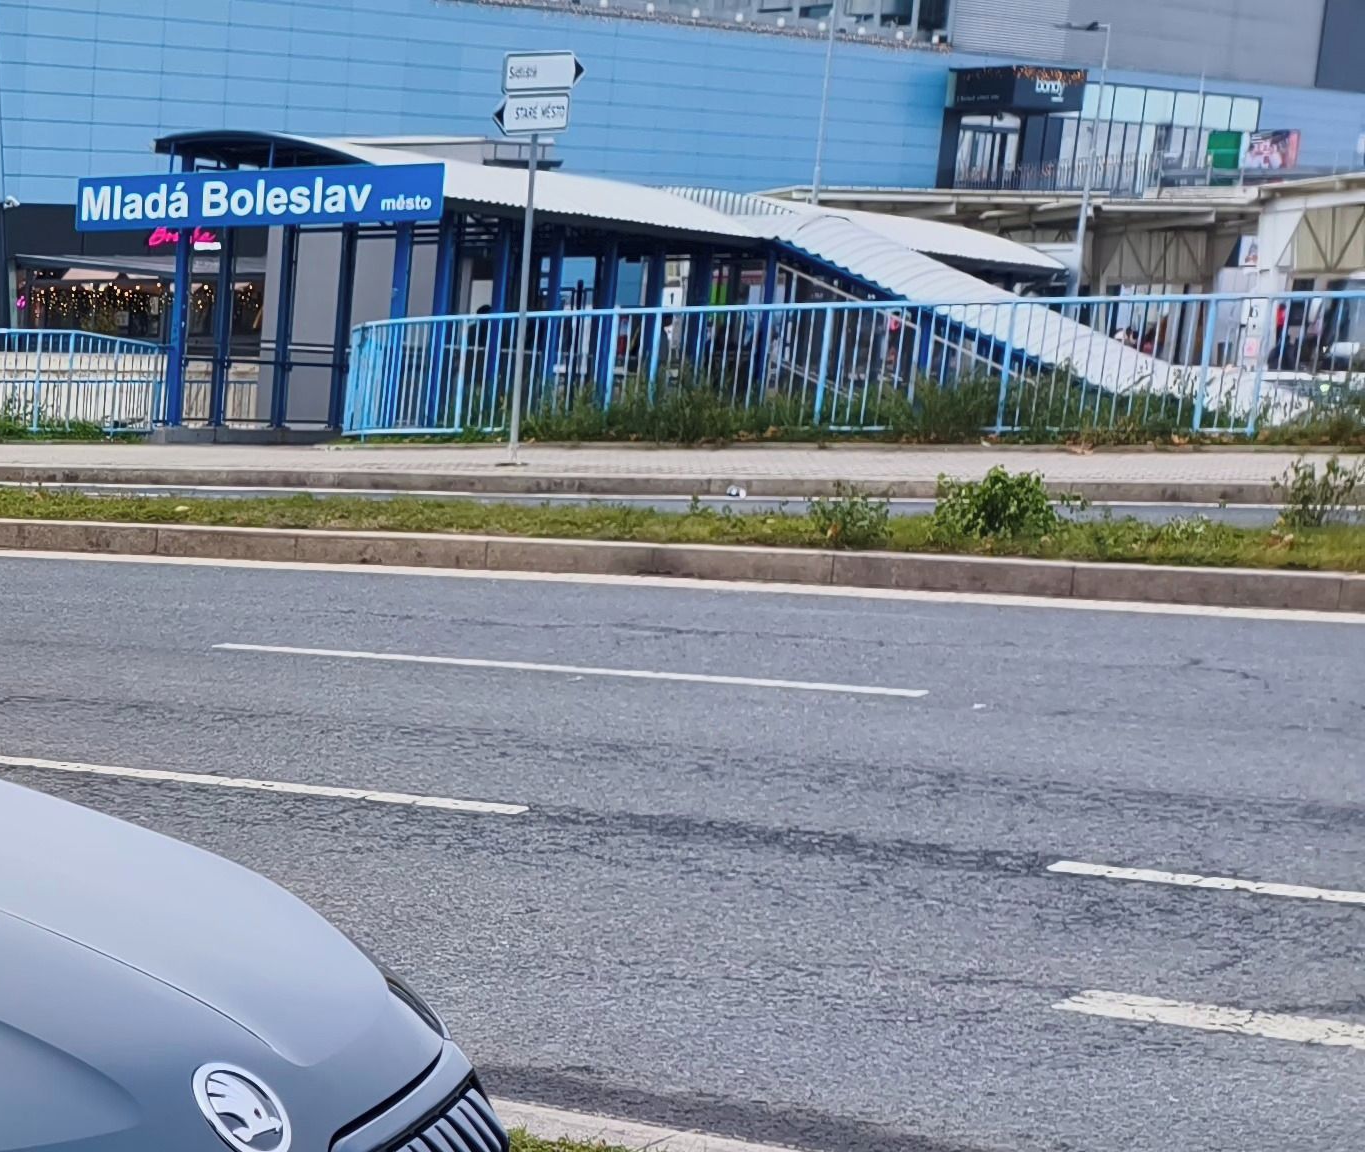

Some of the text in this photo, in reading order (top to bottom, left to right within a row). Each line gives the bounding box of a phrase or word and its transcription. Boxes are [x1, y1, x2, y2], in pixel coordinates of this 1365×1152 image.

[81, 176, 432, 222] Mladá Boleslav město
